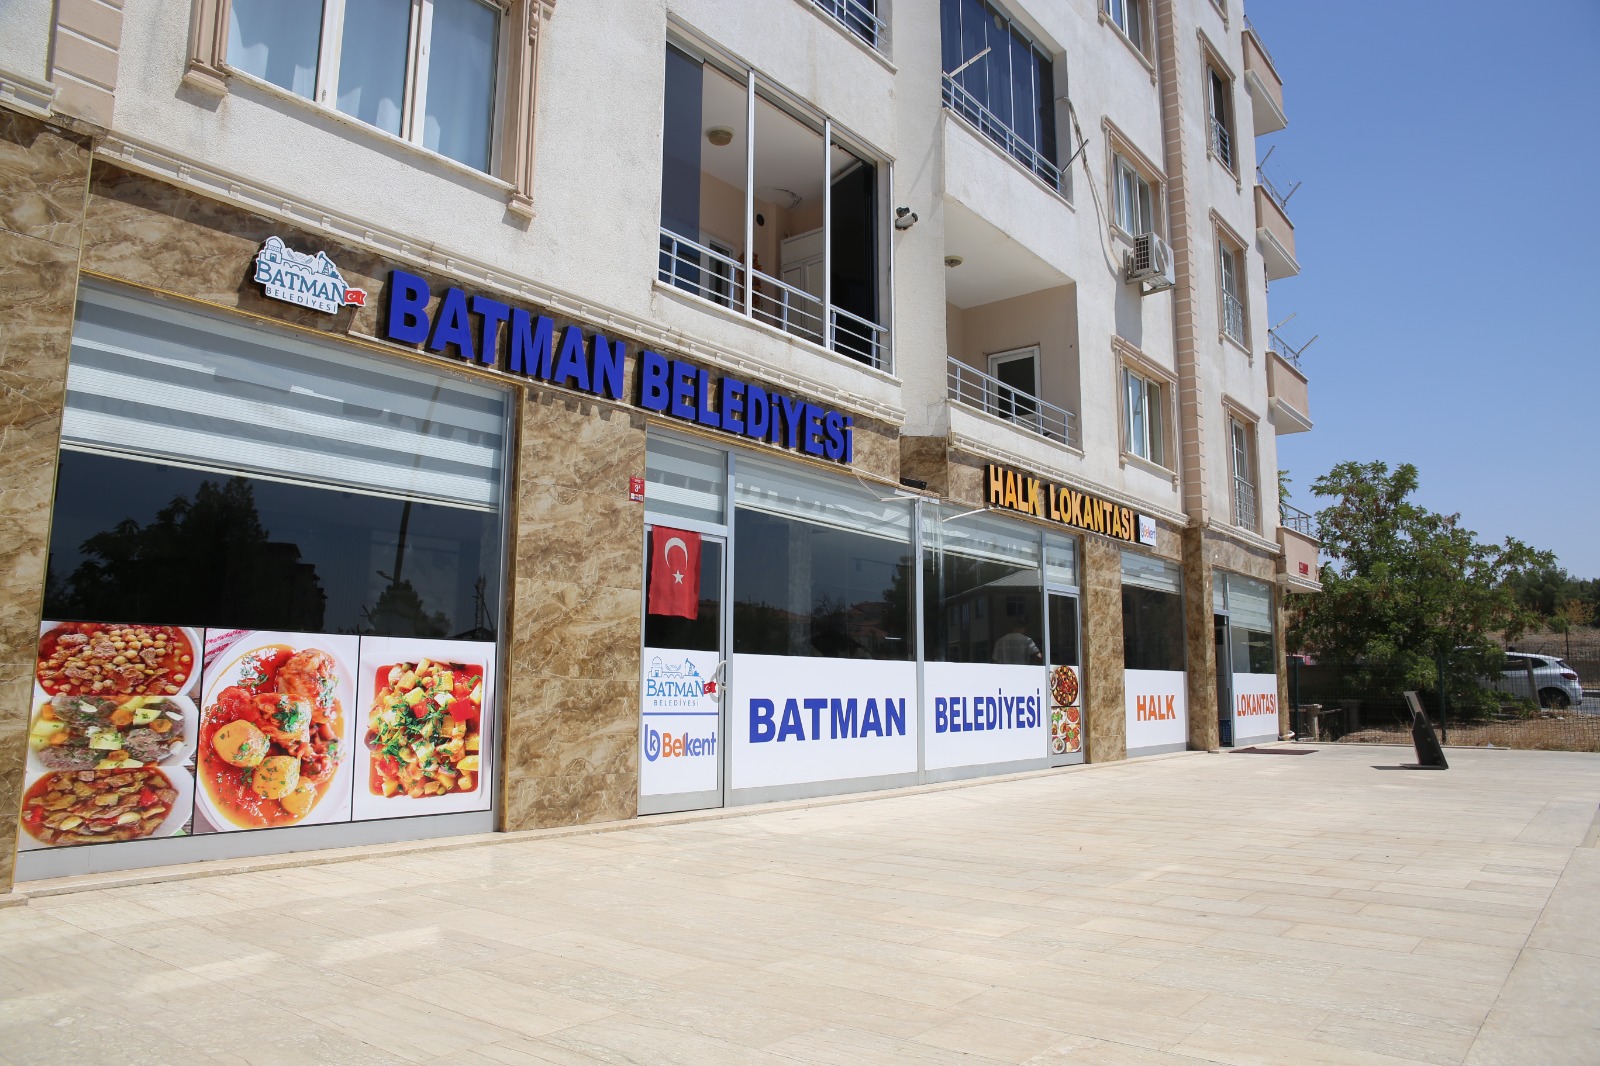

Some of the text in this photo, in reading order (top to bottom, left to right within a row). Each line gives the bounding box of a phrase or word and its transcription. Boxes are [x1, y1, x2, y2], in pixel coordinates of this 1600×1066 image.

[255, 259, 347, 305] BATMAN
[387, 269, 625, 400] BATMAN
[988, 464, 1136, 542] HALK LOKANTASI
[646, 679, 705, 697] BATMAN
[935, 688, 1041, 733] BELEDİYESİ
[1136, 694, 1176, 721] HALK
[1236, 693, 1276, 717] LOKANTASI
[749, 698, 906, 743] BATMAN
[662, 732, 716, 758] Belkent
